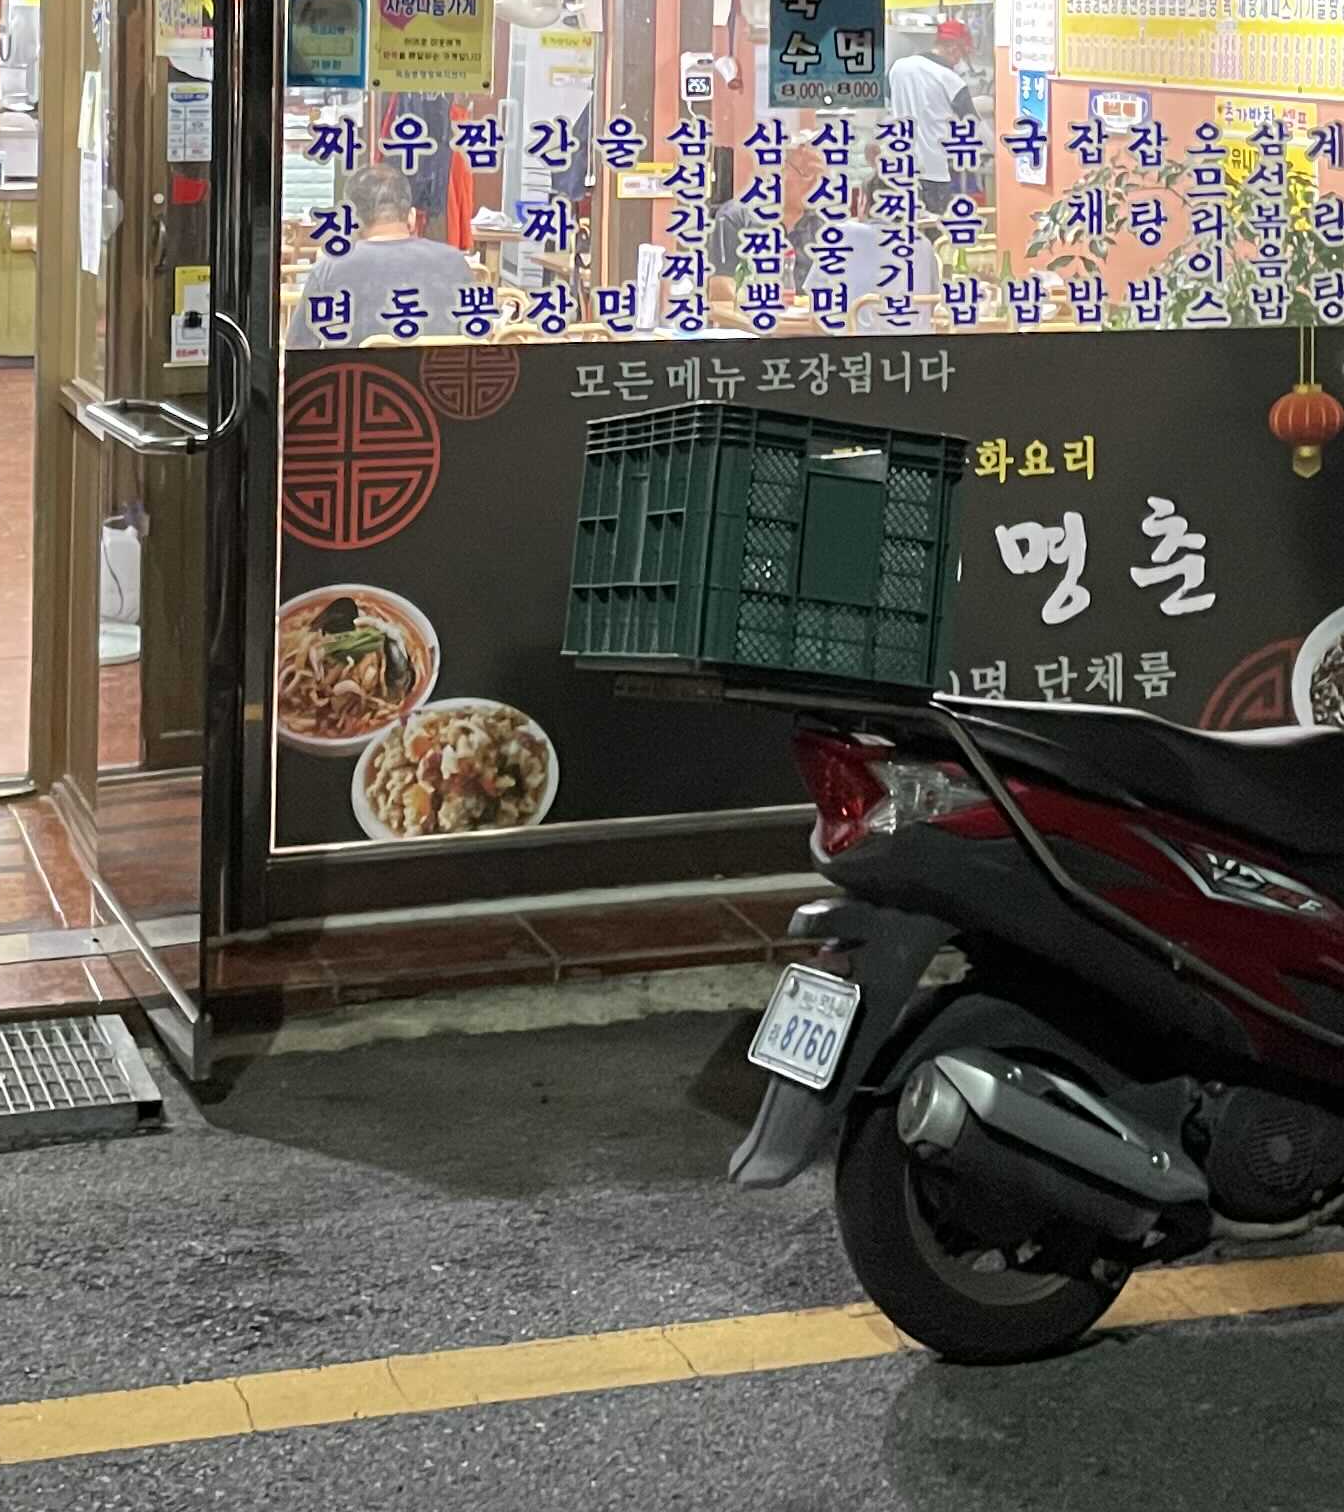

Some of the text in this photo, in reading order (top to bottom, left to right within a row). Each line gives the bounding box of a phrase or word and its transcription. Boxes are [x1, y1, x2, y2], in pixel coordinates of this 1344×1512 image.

[836, 81, 879, 98] 8,000
[309, 119, 360, 341] 짜장면
[382, 119, 433, 336] 우동
[453, 119, 503, 336] 짬뽕
[522, 118, 575, 333] 간짜장
[597, 119, 644, 332] 울면
[663, 119, 712, 332] 삼선간짜장
[740, 120, 788, 331] 삼선짬뽕
[808, 119, 855, 329] 삼선울면
[943, 121, 983, 324] 볶음밥
[1005, 119, 1047, 323] 국밥
[1069, 121, 1108, 323] 잡채밥
[1129, 122, 1167, 322] 잡탕밥
[1188, 127, 1227, 322] 오므라이스
[1252, 125, 1289, 320] 삼선볶음밥
[570, 350, 956, 402] 모든 메뉴 포장됩니다
[965, 435, 1096, 484] 화요리
[957, 496, 1217, 626] 명춘
[1034, 650, 1178, 704] 단체룸
[781, 1015, 837, 1066] 8760
